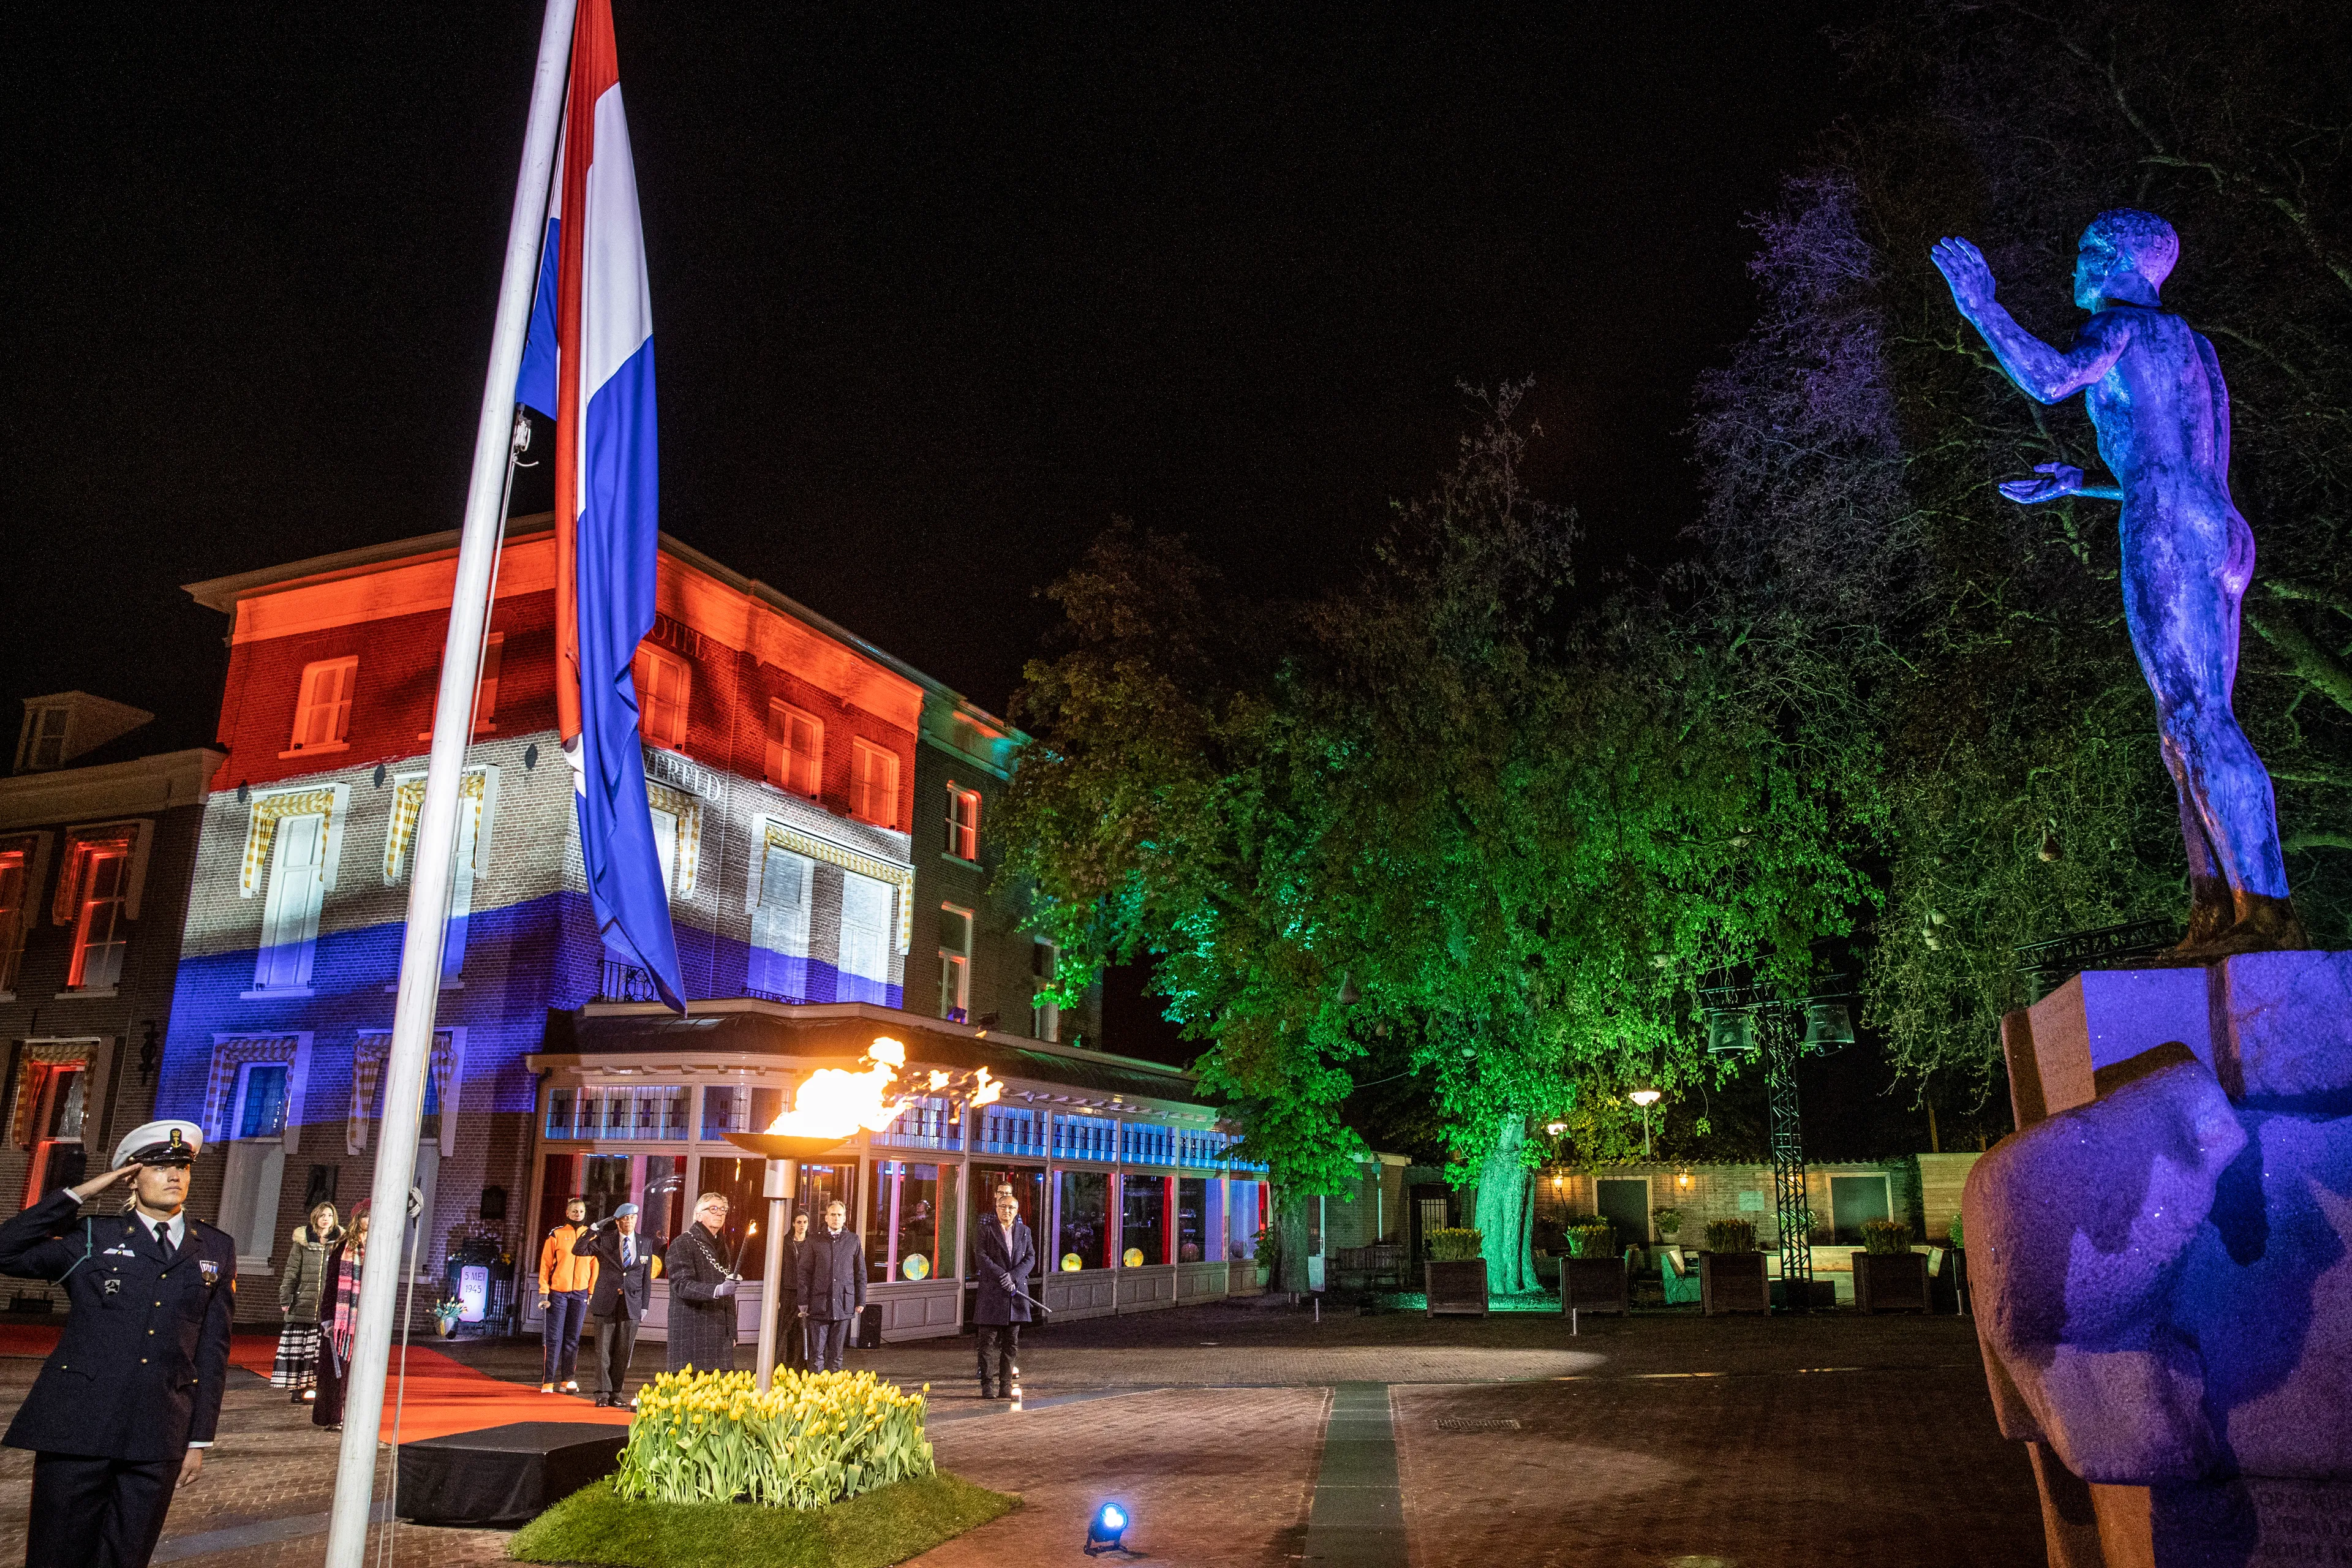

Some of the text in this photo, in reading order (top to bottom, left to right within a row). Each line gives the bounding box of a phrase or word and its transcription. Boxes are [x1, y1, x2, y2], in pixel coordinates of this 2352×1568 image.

[464, 1272, 486, 1281] 5 MEI
[465, 1284, 482, 1294] 1945
